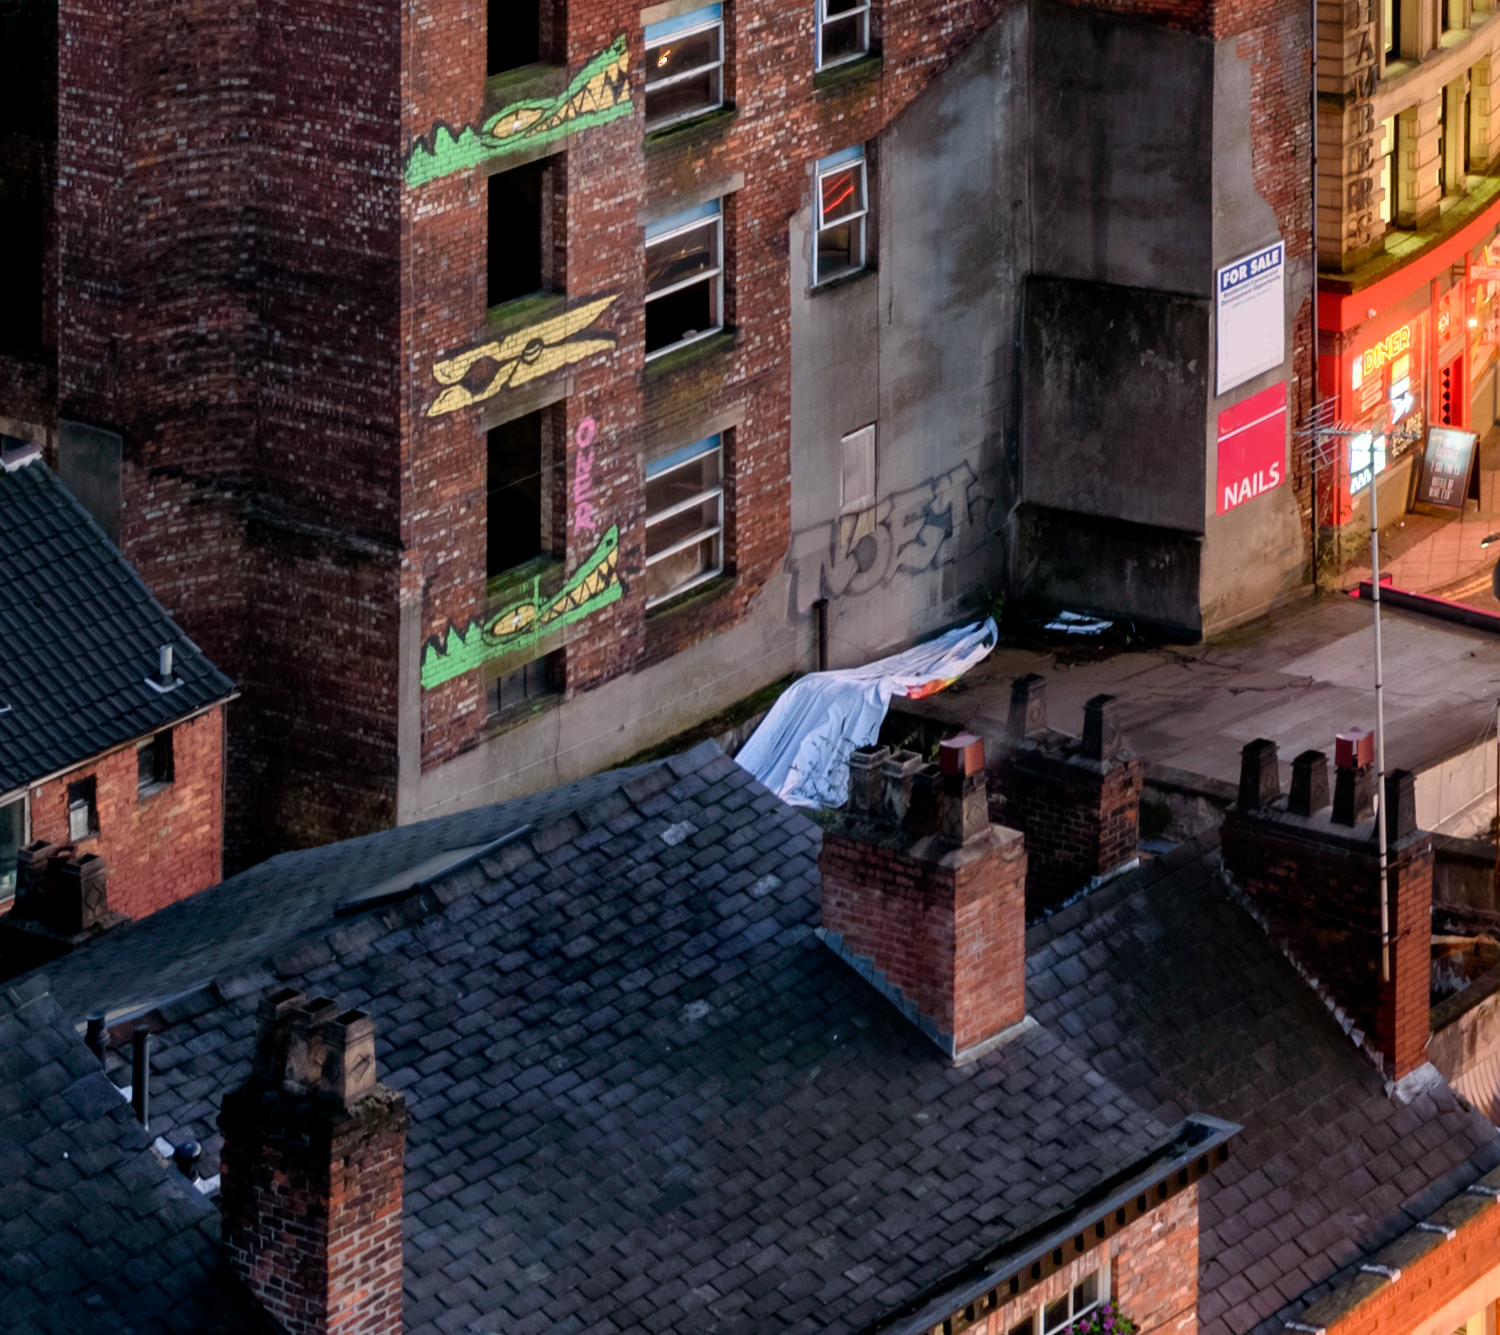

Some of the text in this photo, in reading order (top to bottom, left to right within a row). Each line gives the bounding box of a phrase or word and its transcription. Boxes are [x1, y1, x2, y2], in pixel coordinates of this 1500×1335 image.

[1222, 249, 1280, 289] FOR SALE
[1363, 325, 1411, 376] DINER
[1223, 461, 1281, 512] NAILS
